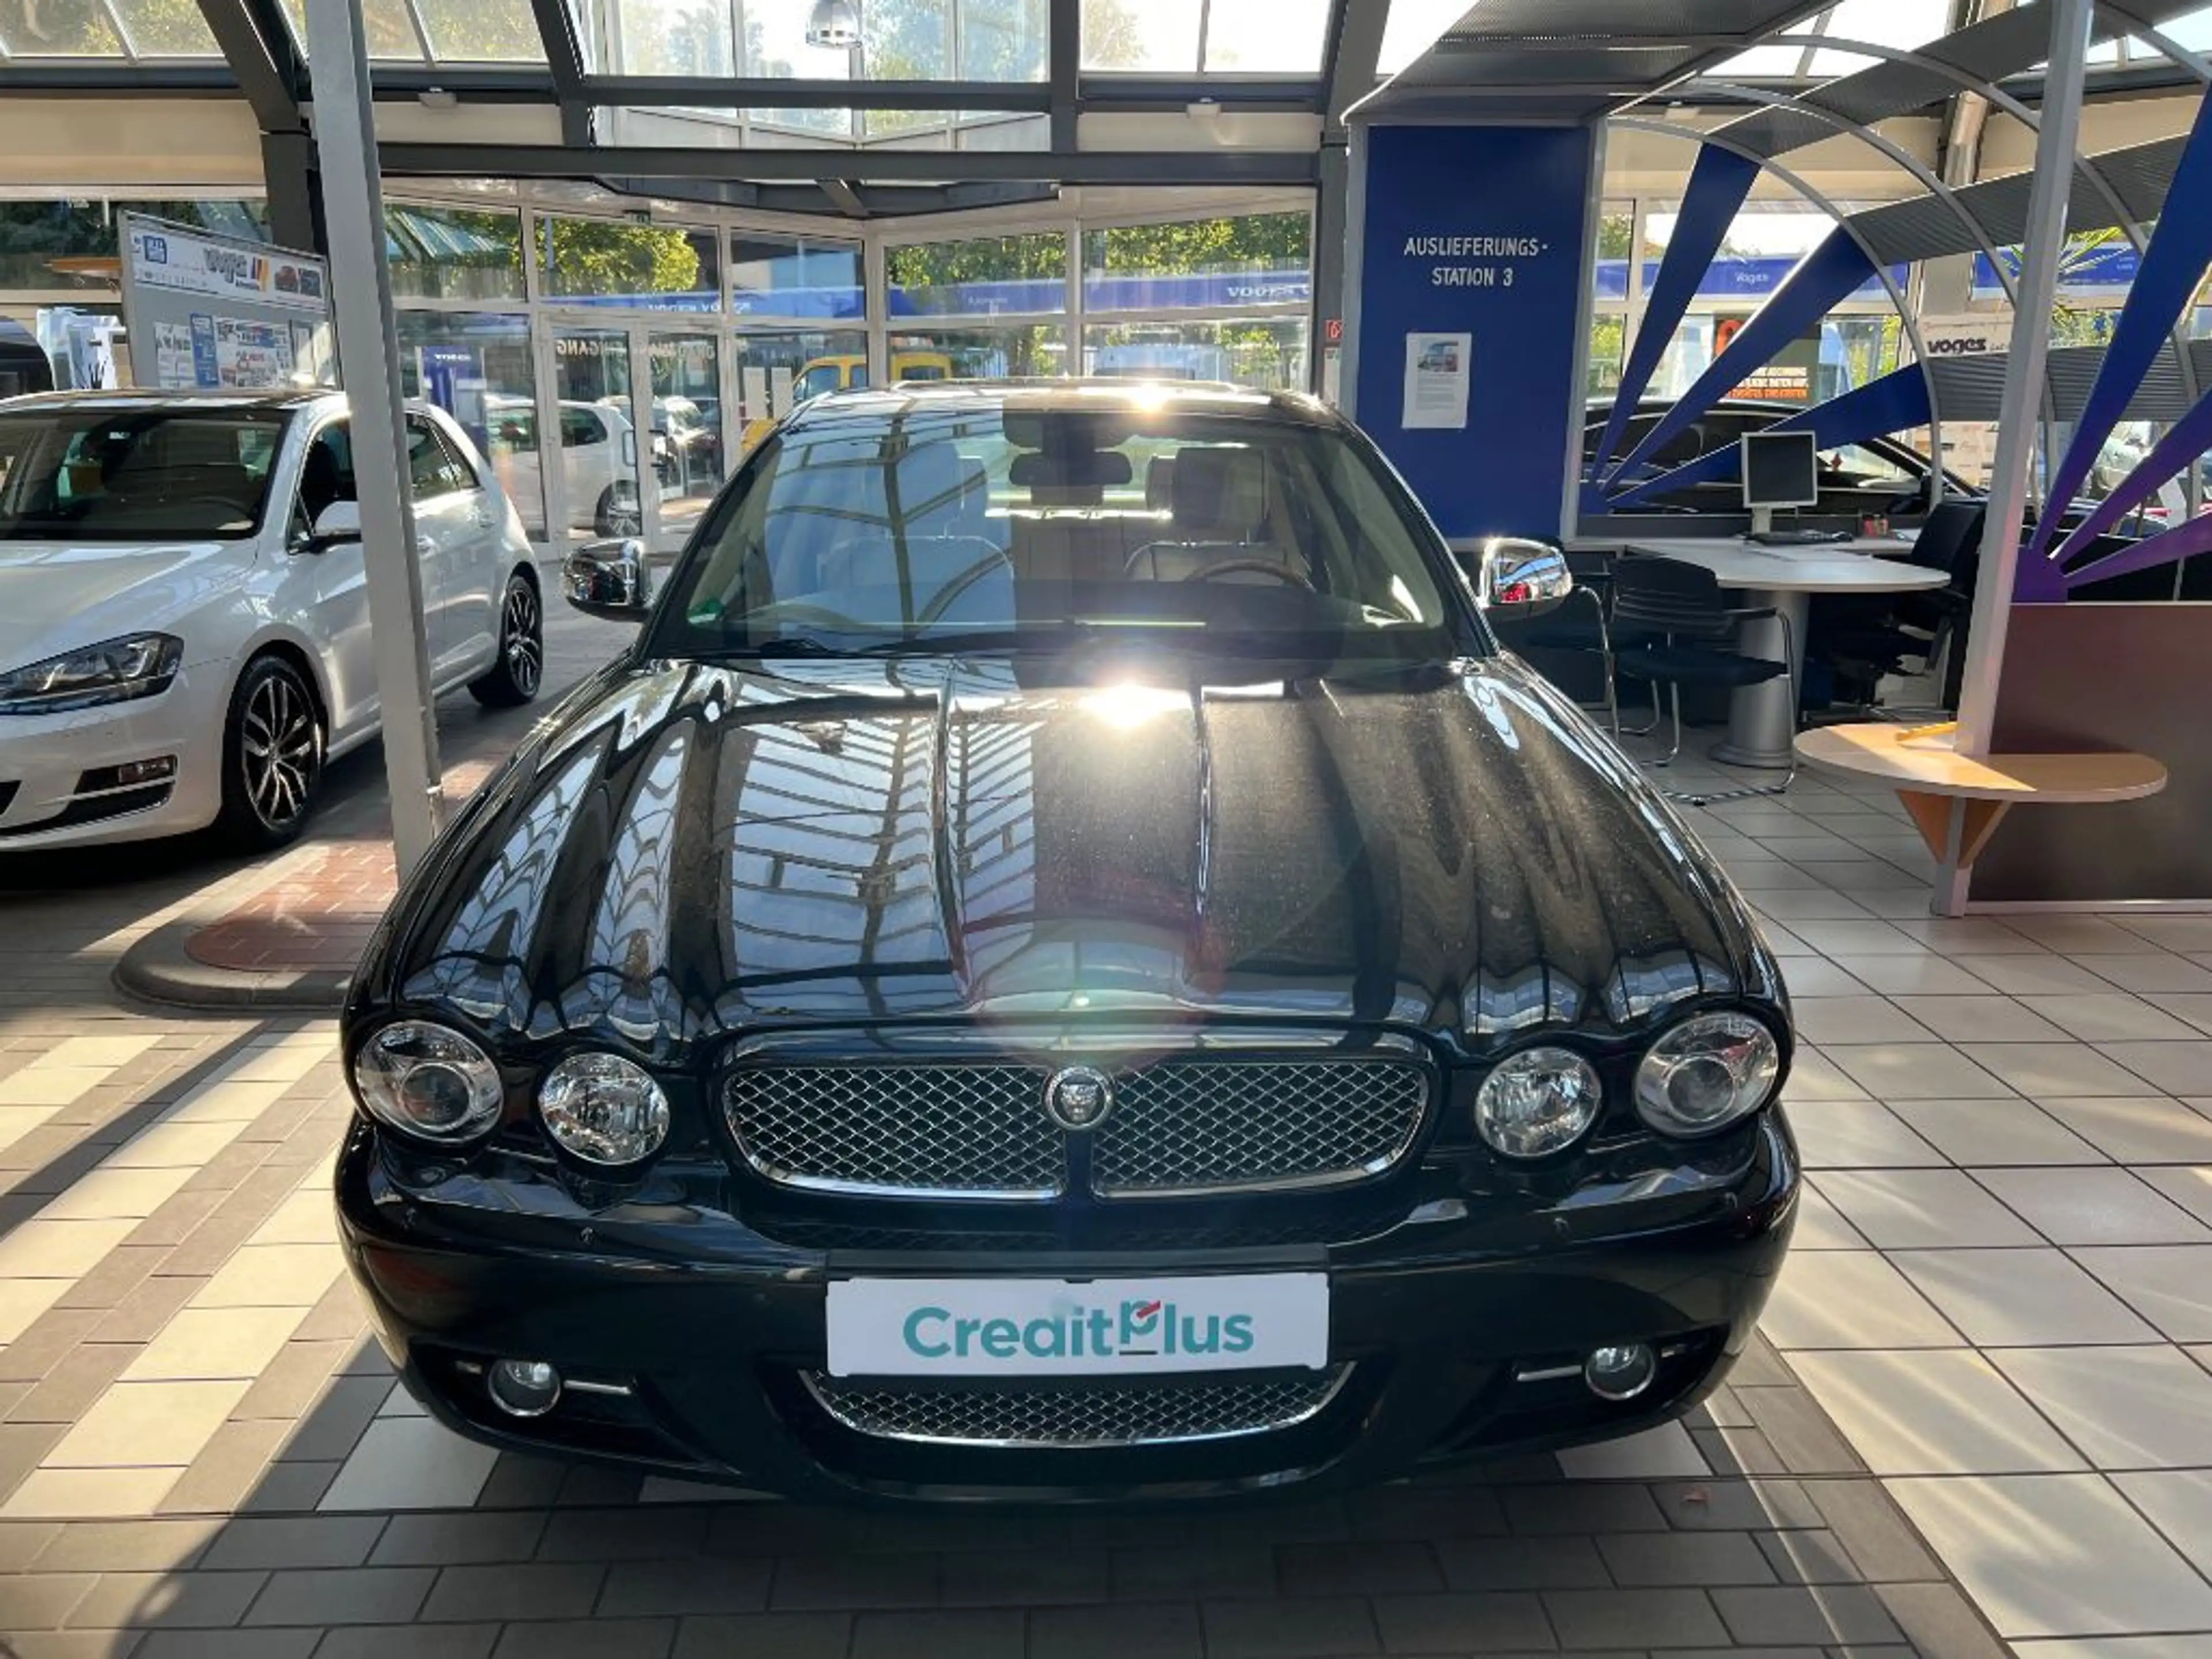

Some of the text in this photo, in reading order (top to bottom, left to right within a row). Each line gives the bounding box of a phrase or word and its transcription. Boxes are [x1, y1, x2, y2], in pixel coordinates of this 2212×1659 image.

[1403, 237, 1548, 256] AUSLIEFERUNGS-
[1431, 267, 1514, 287] STATION 3
